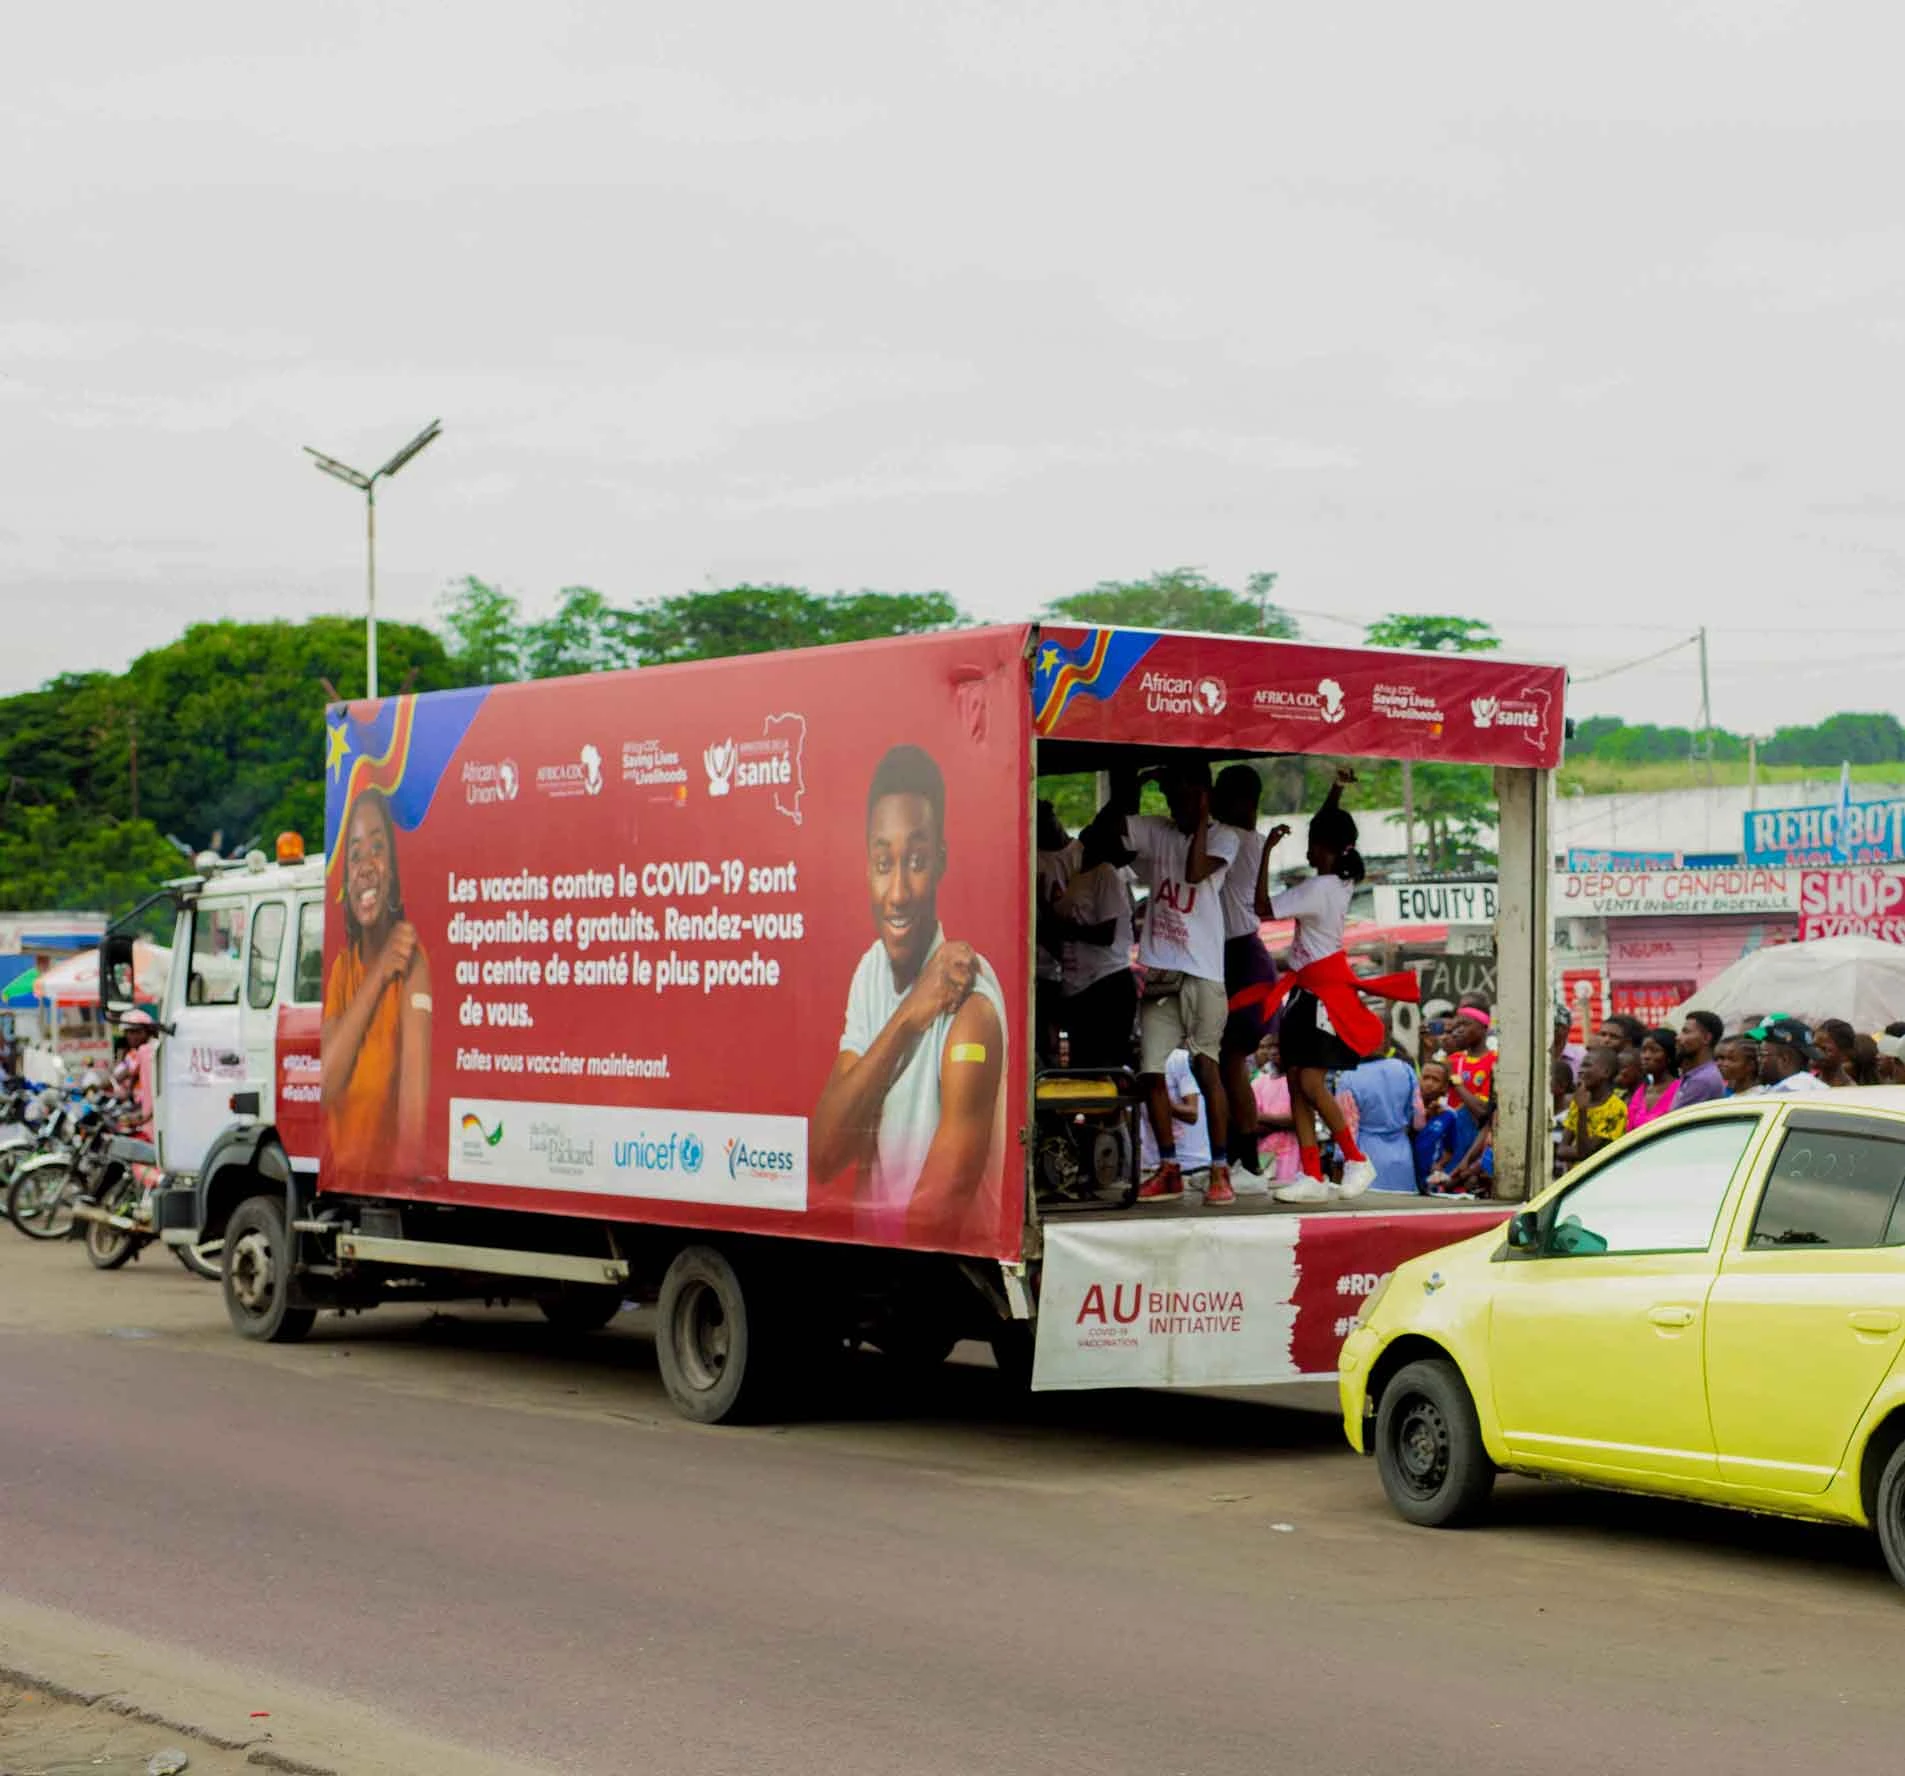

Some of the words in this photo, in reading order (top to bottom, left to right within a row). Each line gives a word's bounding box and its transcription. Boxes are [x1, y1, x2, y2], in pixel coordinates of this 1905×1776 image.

[1140, 672, 1194, 695] African
[1254, 689, 1296, 705] AFRICA
[1296, 693, 1322, 708] CDC
[1147, 693, 1192, 715] Union
[1409, 694, 1437, 709] Lives
[1496, 708, 1538, 728] santé
[735, 750, 791, 787] santé
[449, 872, 477, 903] Les
[481, 869, 549, 902] vaccins
[552, 869, 614, 900] contre
[619, 864, 638, 897] le
[642, 860, 745, 897] COVID-19
[749, 861, 798, 893] sont
[1155, 878, 1197, 914] AU
[1565, 874, 1653, 899] DEPOT
[1662, 870, 1789, 901] CANADIAN
[1802, 872, 1904, 919] SHOP
[1399, 887, 1475, 919] EQUITY
[448, 909, 549, 951] disponibles
[552, 912, 573, 943] et
[577, 907, 660, 951] gratuits.
[665, 906, 805, 942] Rendez-vous
[456, 959, 479, 986] au
[483, 956, 542, 985] centre
[545, 953, 570, 985] de
[573, 952, 629, 985] santé
[632, 951, 652, 985] le
[655, 950, 701, 994] plus
[704, 951, 780, 994] proche
[459, 994, 483, 1027] de
[487, 1000, 535, 1028] vous.
[494, 1052, 525, 1073] vous
[527, 1051, 587, 1076] vacciner
[613, 1131, 679, 1171] unicef
[736, 1142, 793, 1171] Access
[1076, 1283, 1143, 1325] AU
[1148, 1291, 1245, 1314] BINGWA
[1149, 1315, 1242, 1335] INITIATIVE
